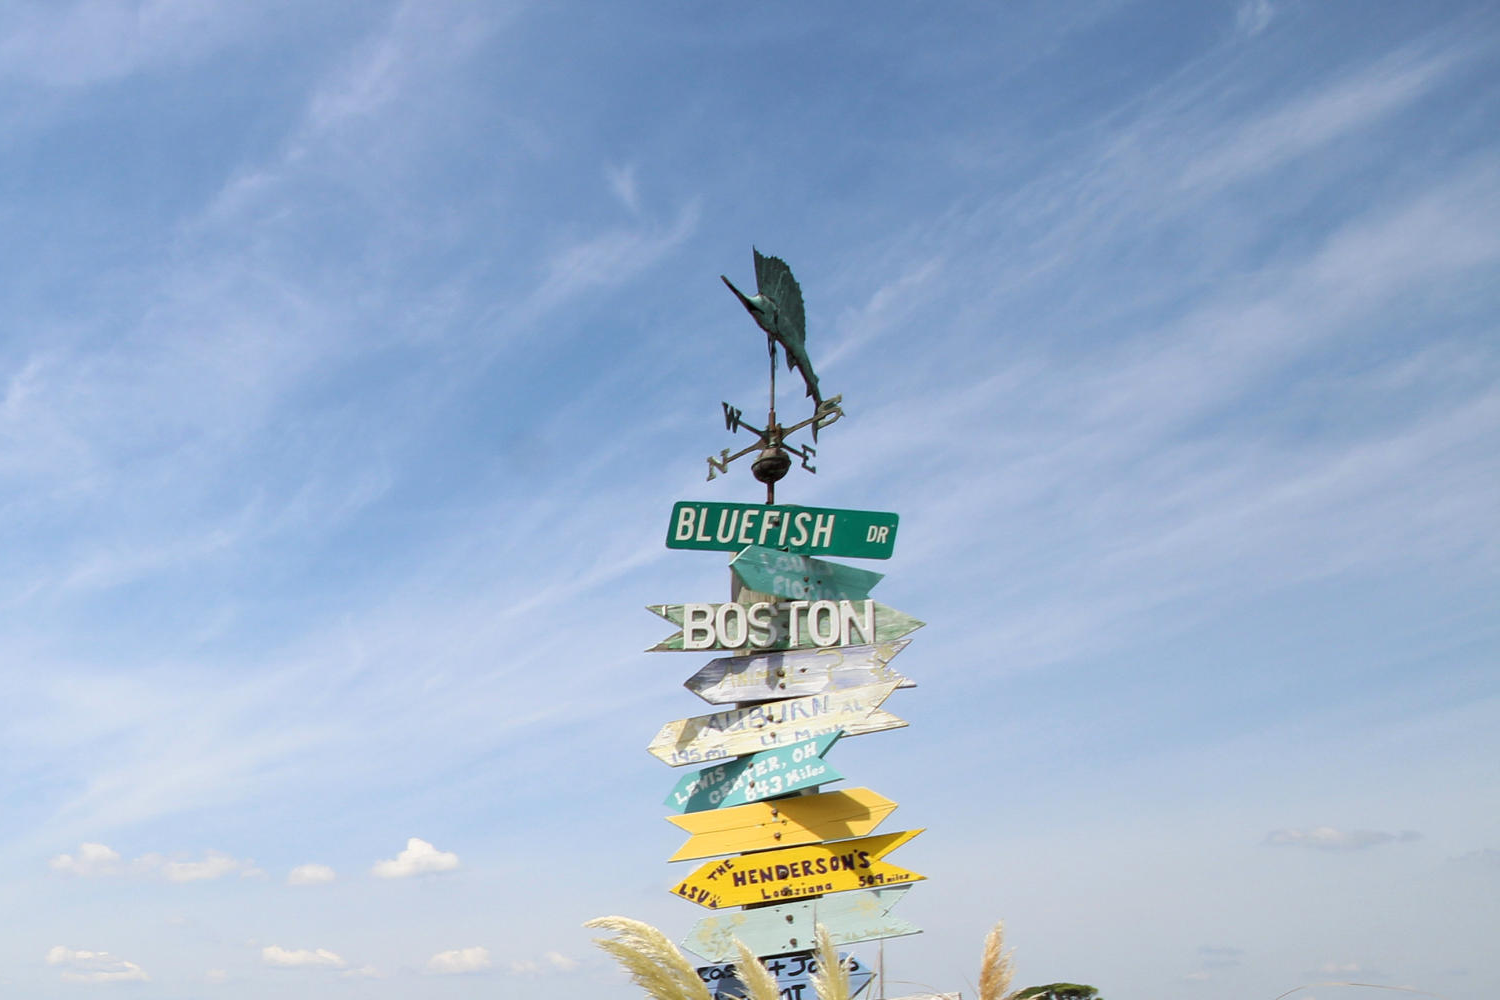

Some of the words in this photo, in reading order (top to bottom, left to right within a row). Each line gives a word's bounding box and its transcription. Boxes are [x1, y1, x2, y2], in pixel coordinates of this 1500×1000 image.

[674, 506, 836, 548] BLUEFISH
[866, 525, 889, 544] DR
[683, 599, 876, 650] BOSTON
[707, 694, 828, 732] AUBURN
[792, 741, 818, 763] OH
[674, 766, 726, 805] LEWIS
[707, 859, 735, 881] THE
[732, 849, 872, 888] HENDERSON'S
[858, 872, 885, 887] 509
[678, 883, 711, 904] LSU
